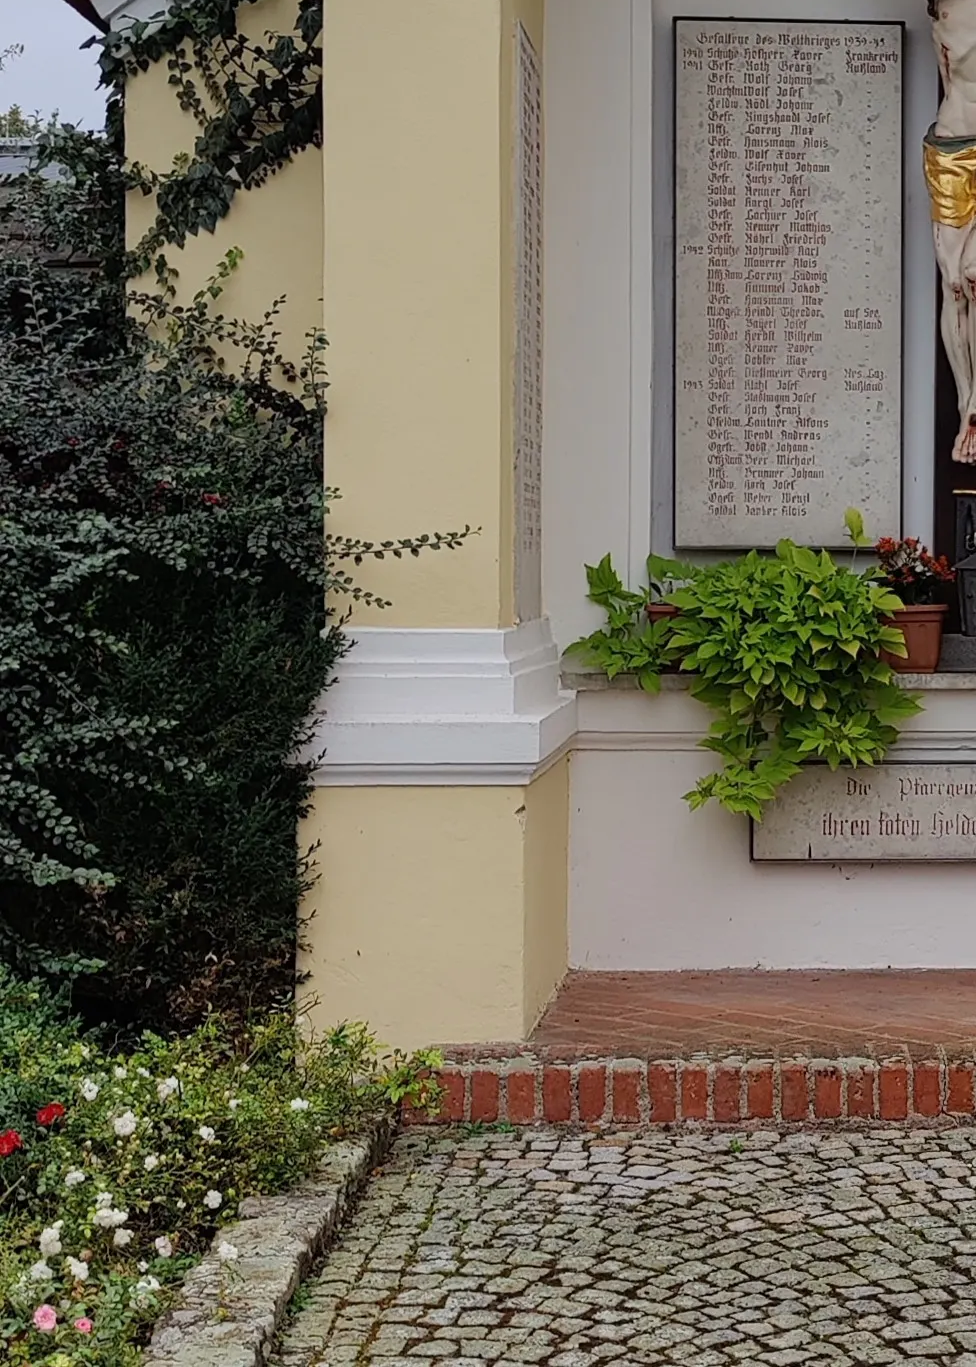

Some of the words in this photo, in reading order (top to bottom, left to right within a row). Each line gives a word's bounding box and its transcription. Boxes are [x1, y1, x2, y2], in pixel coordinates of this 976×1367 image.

[756, 33, 773, 44] des
[778, 62, 812, 74] Georg
[745, 149, 769, 159] Wolf
[794, 211, 819, 221] Josef
[846, 777, 871, 796] Die
[822, 812, 870, 839] ihren
[878, 812, 921, 838] toten
